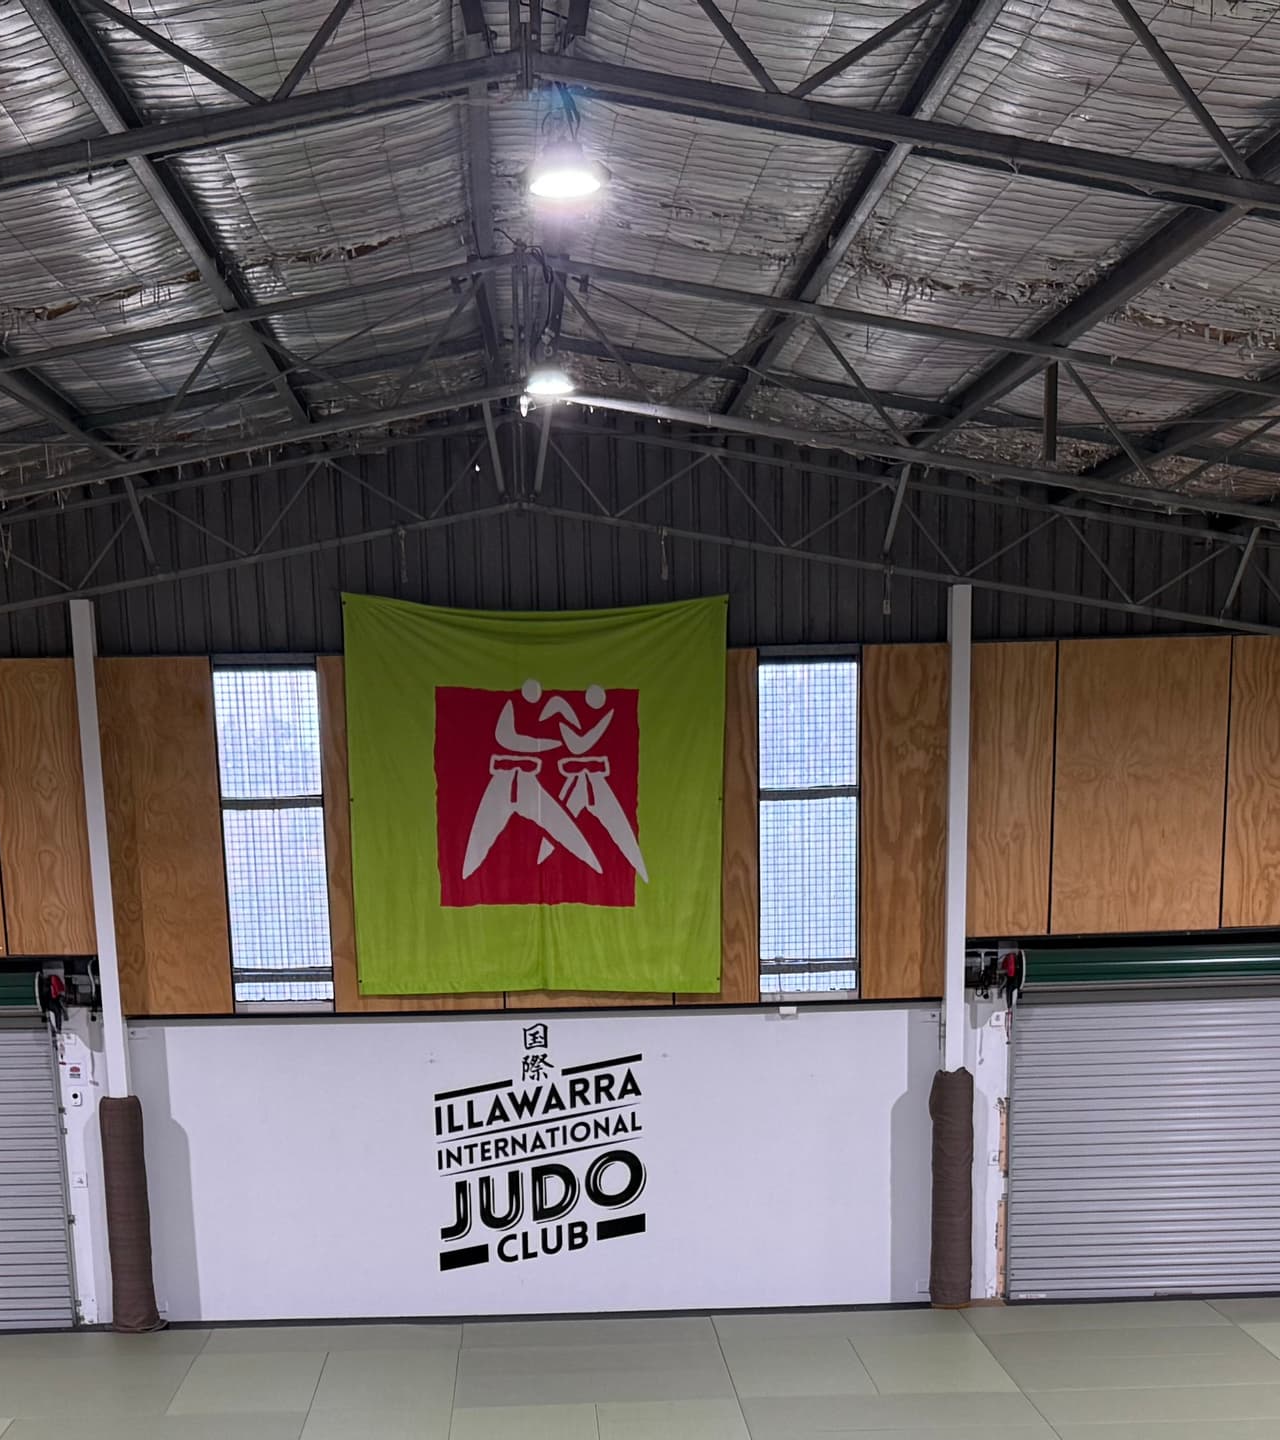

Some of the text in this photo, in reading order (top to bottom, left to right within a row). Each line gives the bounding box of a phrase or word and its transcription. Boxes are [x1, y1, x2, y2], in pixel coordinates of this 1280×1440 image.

[521, 1023, 554, 1082] 国際
[434, 1068, 642, 1136] ILLAWARRA
[437, 1111, 642, 1170] INTERNATIONAL
[440, 1149, 646, 1242] JUDO
[497, 1220, 589, 1263] CLUB
